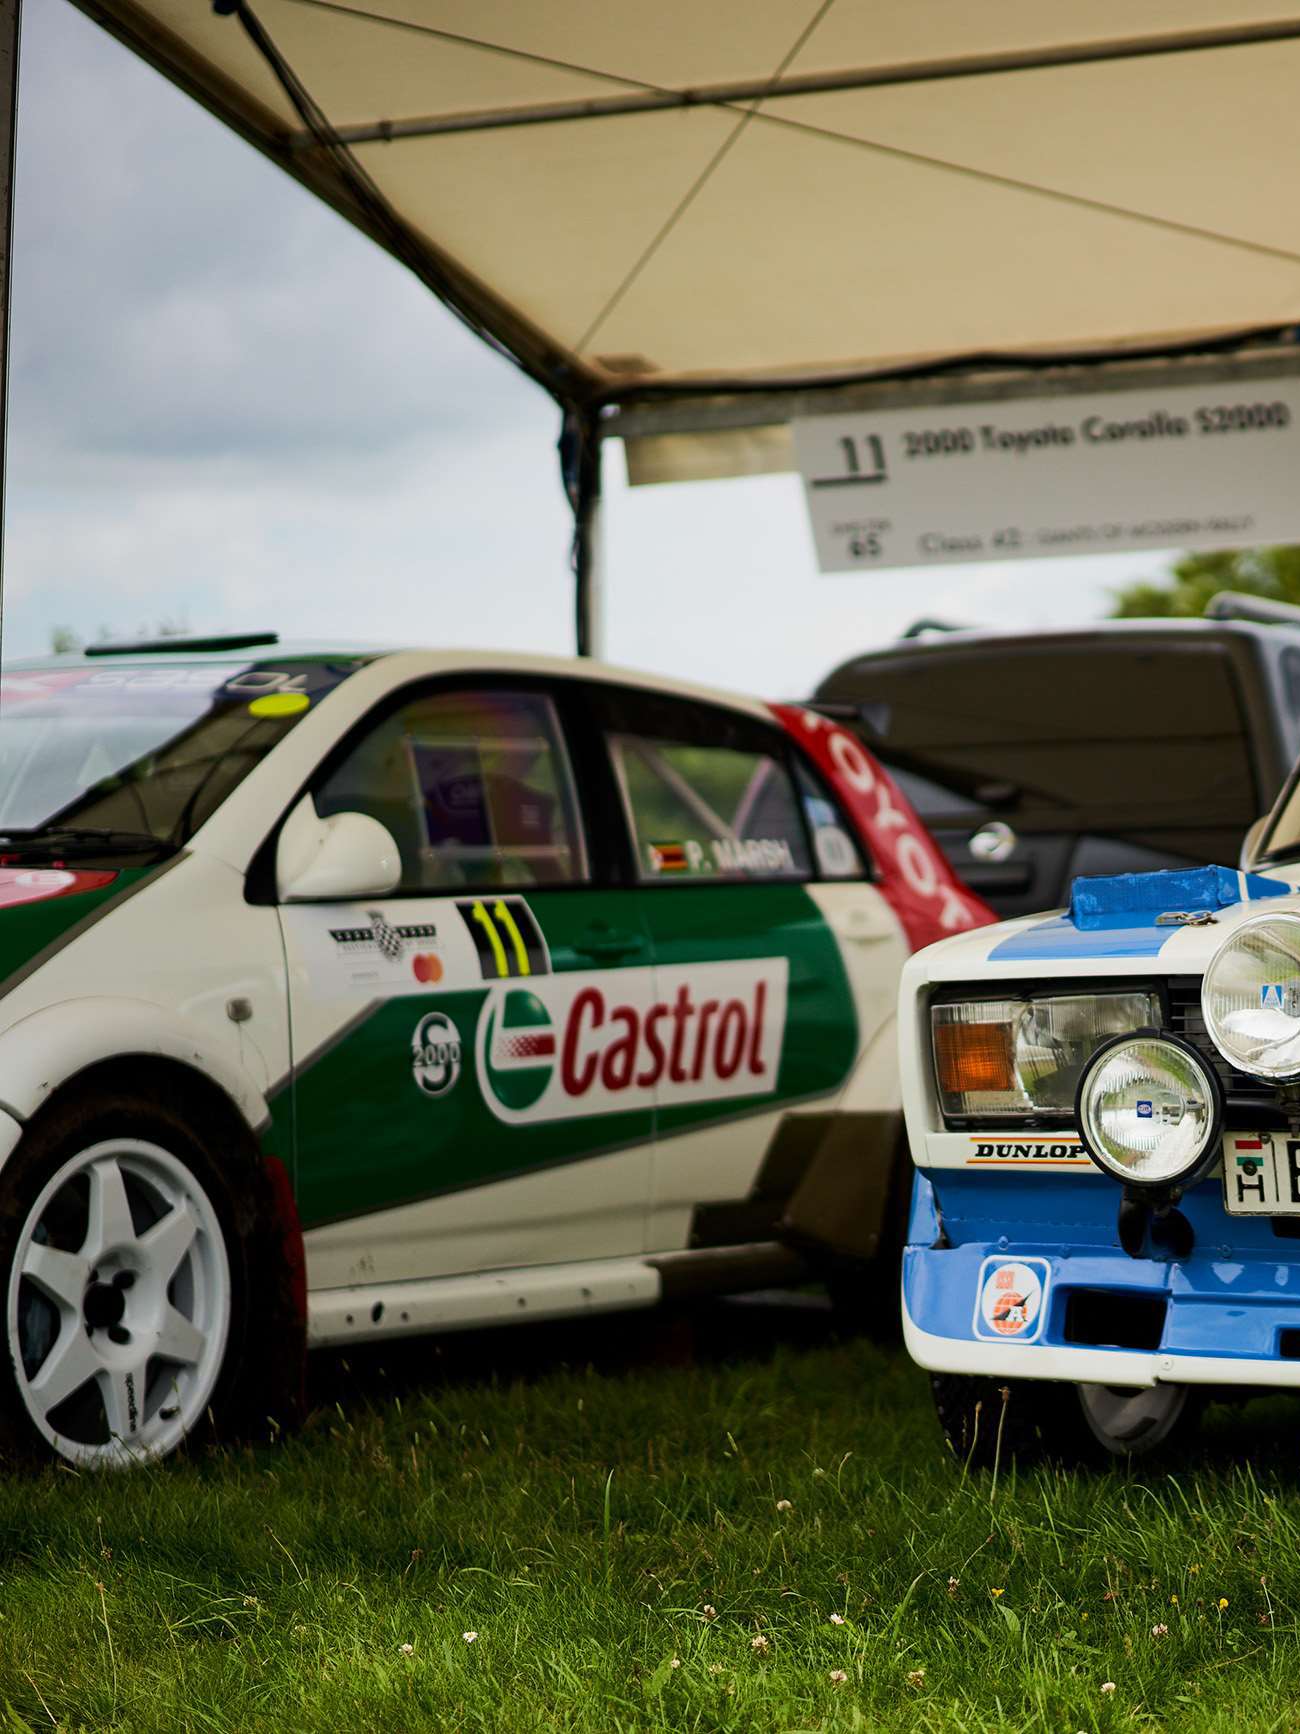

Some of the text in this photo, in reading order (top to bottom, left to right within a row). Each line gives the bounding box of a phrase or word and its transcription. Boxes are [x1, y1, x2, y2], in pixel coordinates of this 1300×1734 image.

[903, 400, 1292, 460] 2000 Toyota Corolla S2000
[839, 433, 886, 473] 11
[412, 1042, 461, 1068] 2000
[560, 978, 766, 1099] Castrol
[975, 1144, 1087, 1159] DUNLOP
[1237, 1174, 1266, 1203] H
